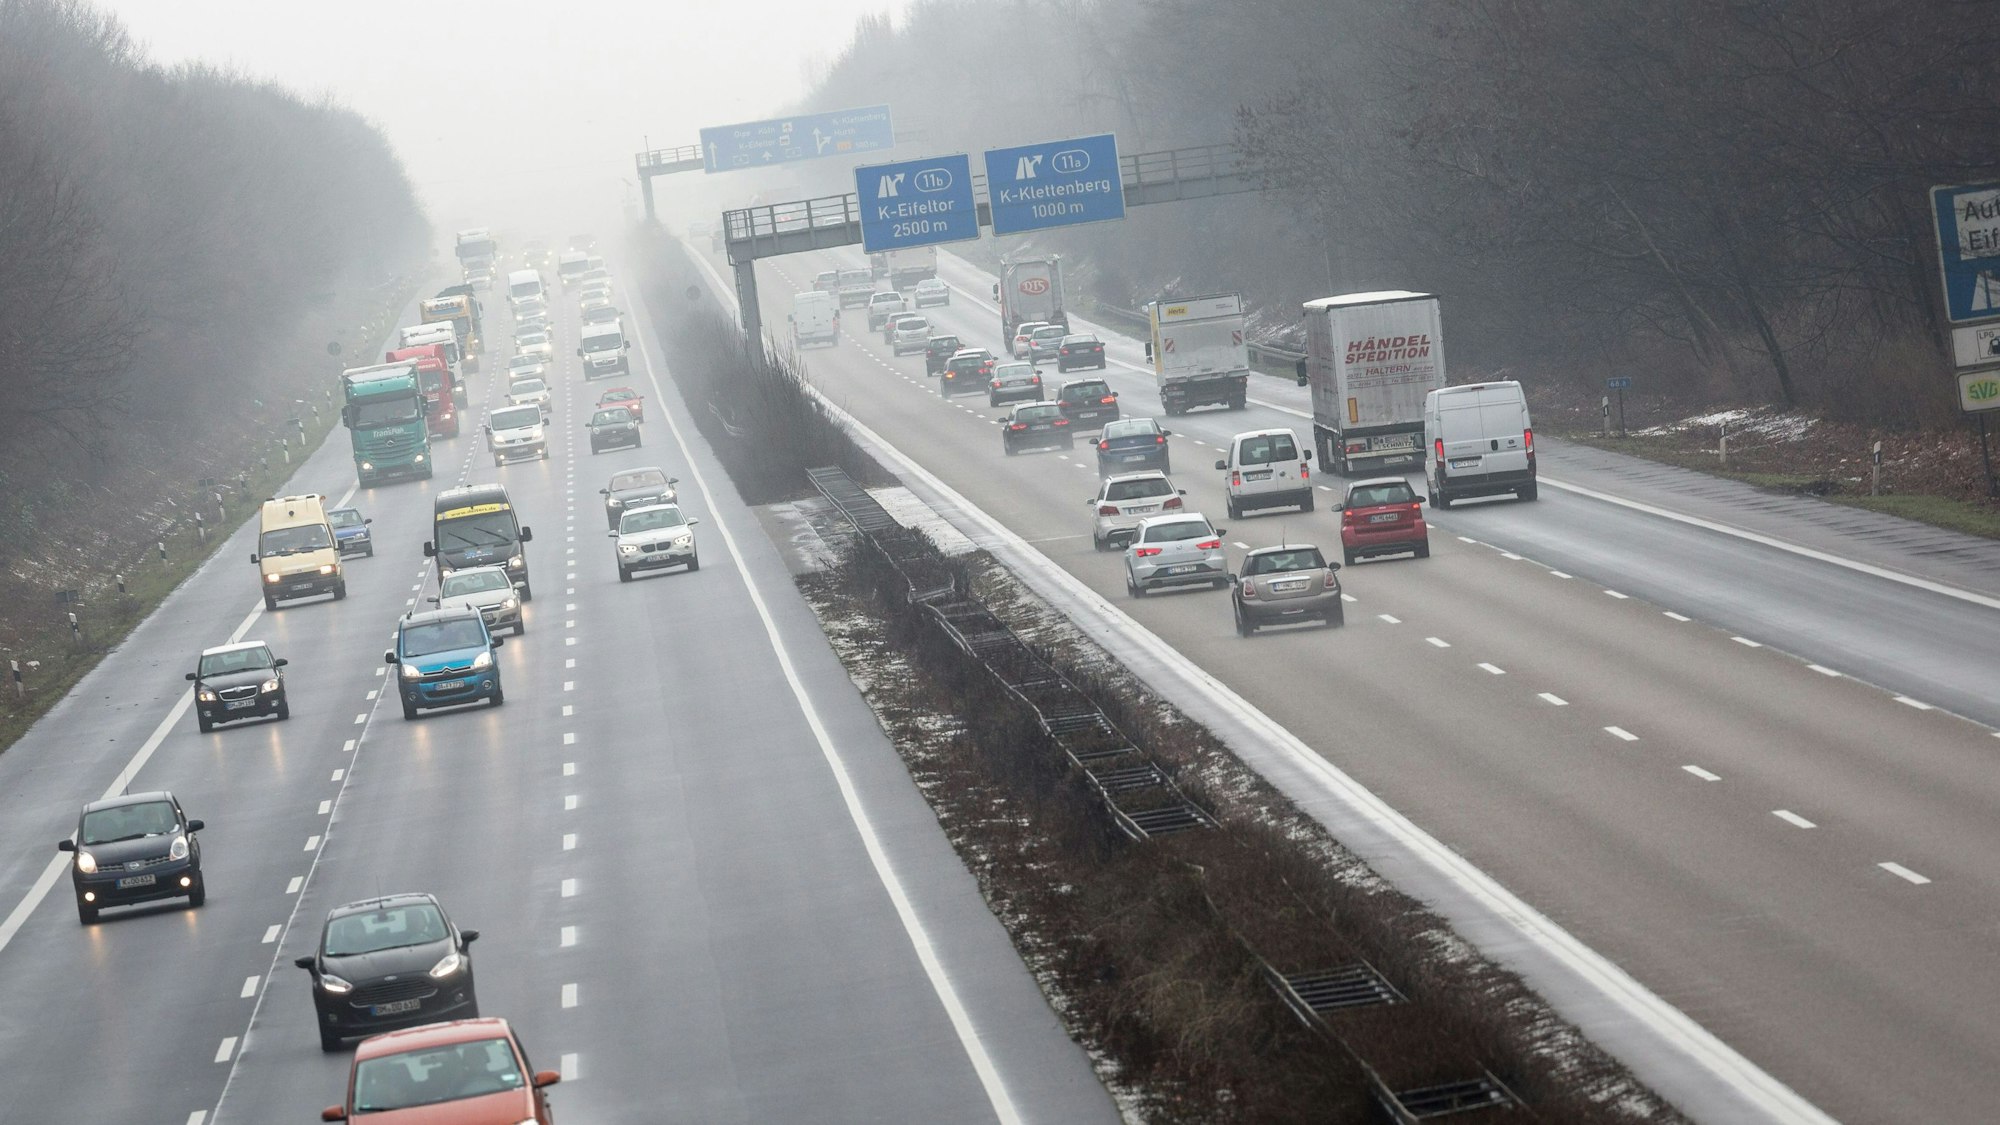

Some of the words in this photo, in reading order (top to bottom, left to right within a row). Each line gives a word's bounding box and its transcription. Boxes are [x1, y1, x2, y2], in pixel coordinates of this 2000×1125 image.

[1061, 155, 1081, 169] 11a
[923, 173, 943, 187] 11b
[1000, 179, 1110, 203] K-Klettenberg
[878, 199, 954, 220] K-Eifeltor
[1032, 202, 1066, 218] 1000
[1070, 203, 1083, 213] m
[892, 219, 929, 238] 2500
[933, 220, 948, 232] m
[1168, 307, 1186, 315] Hertz
[1347, 334, 1431, 352] HÄNDEL
[1979, 331, 1995, 340] LPG
[1345, 346, 1429, 364] SPEDITION
[1365, 364, 1411, 376] HALTERN
[1969, 382, 1998, 400] SVG
[1382, 440, 1413, 449] SCHMITZ
